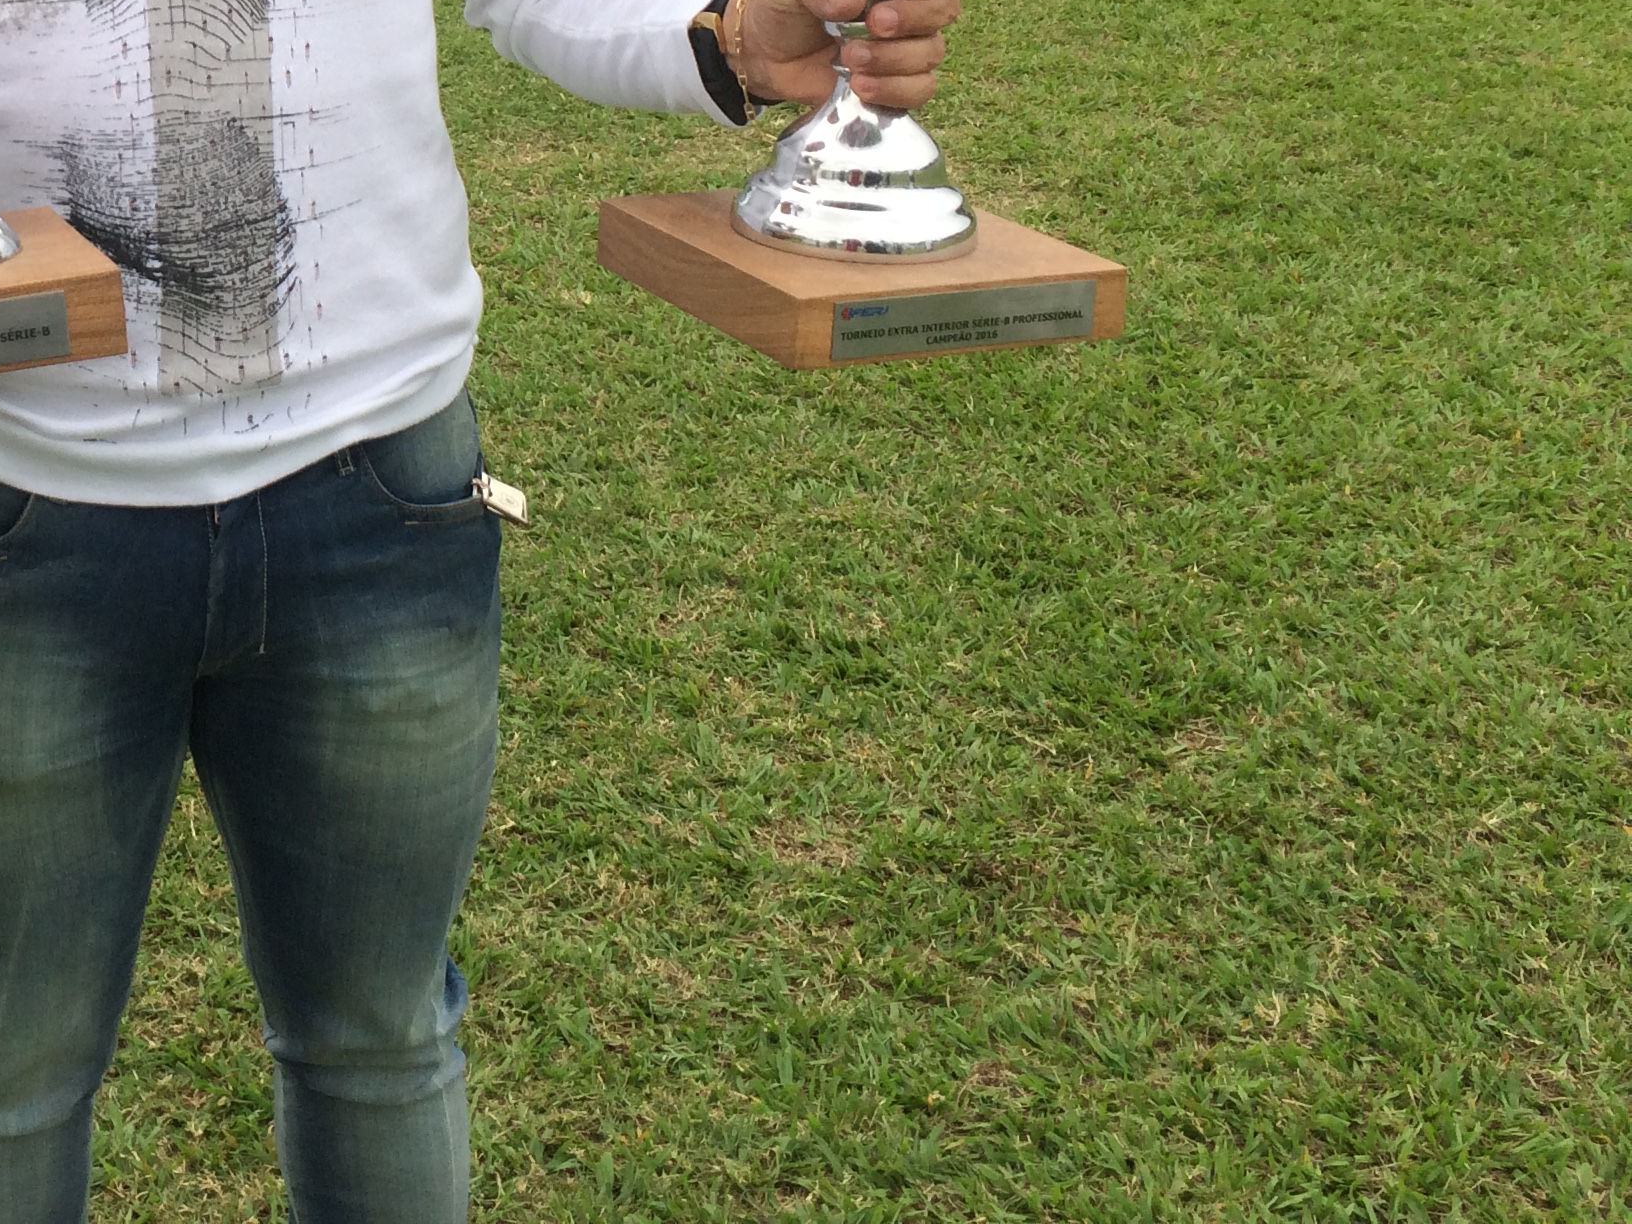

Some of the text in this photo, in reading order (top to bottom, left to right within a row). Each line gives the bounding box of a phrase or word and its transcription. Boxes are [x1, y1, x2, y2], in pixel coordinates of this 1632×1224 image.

[0, 325, 51, 343] SÉRIE-B
[841, 310, 1084, 342] TORNEIO EXTRA INTERIOR SÉRIE-B PROFISSIONAL
[926, 329, 998, 345] CAMPEÃO 2016
